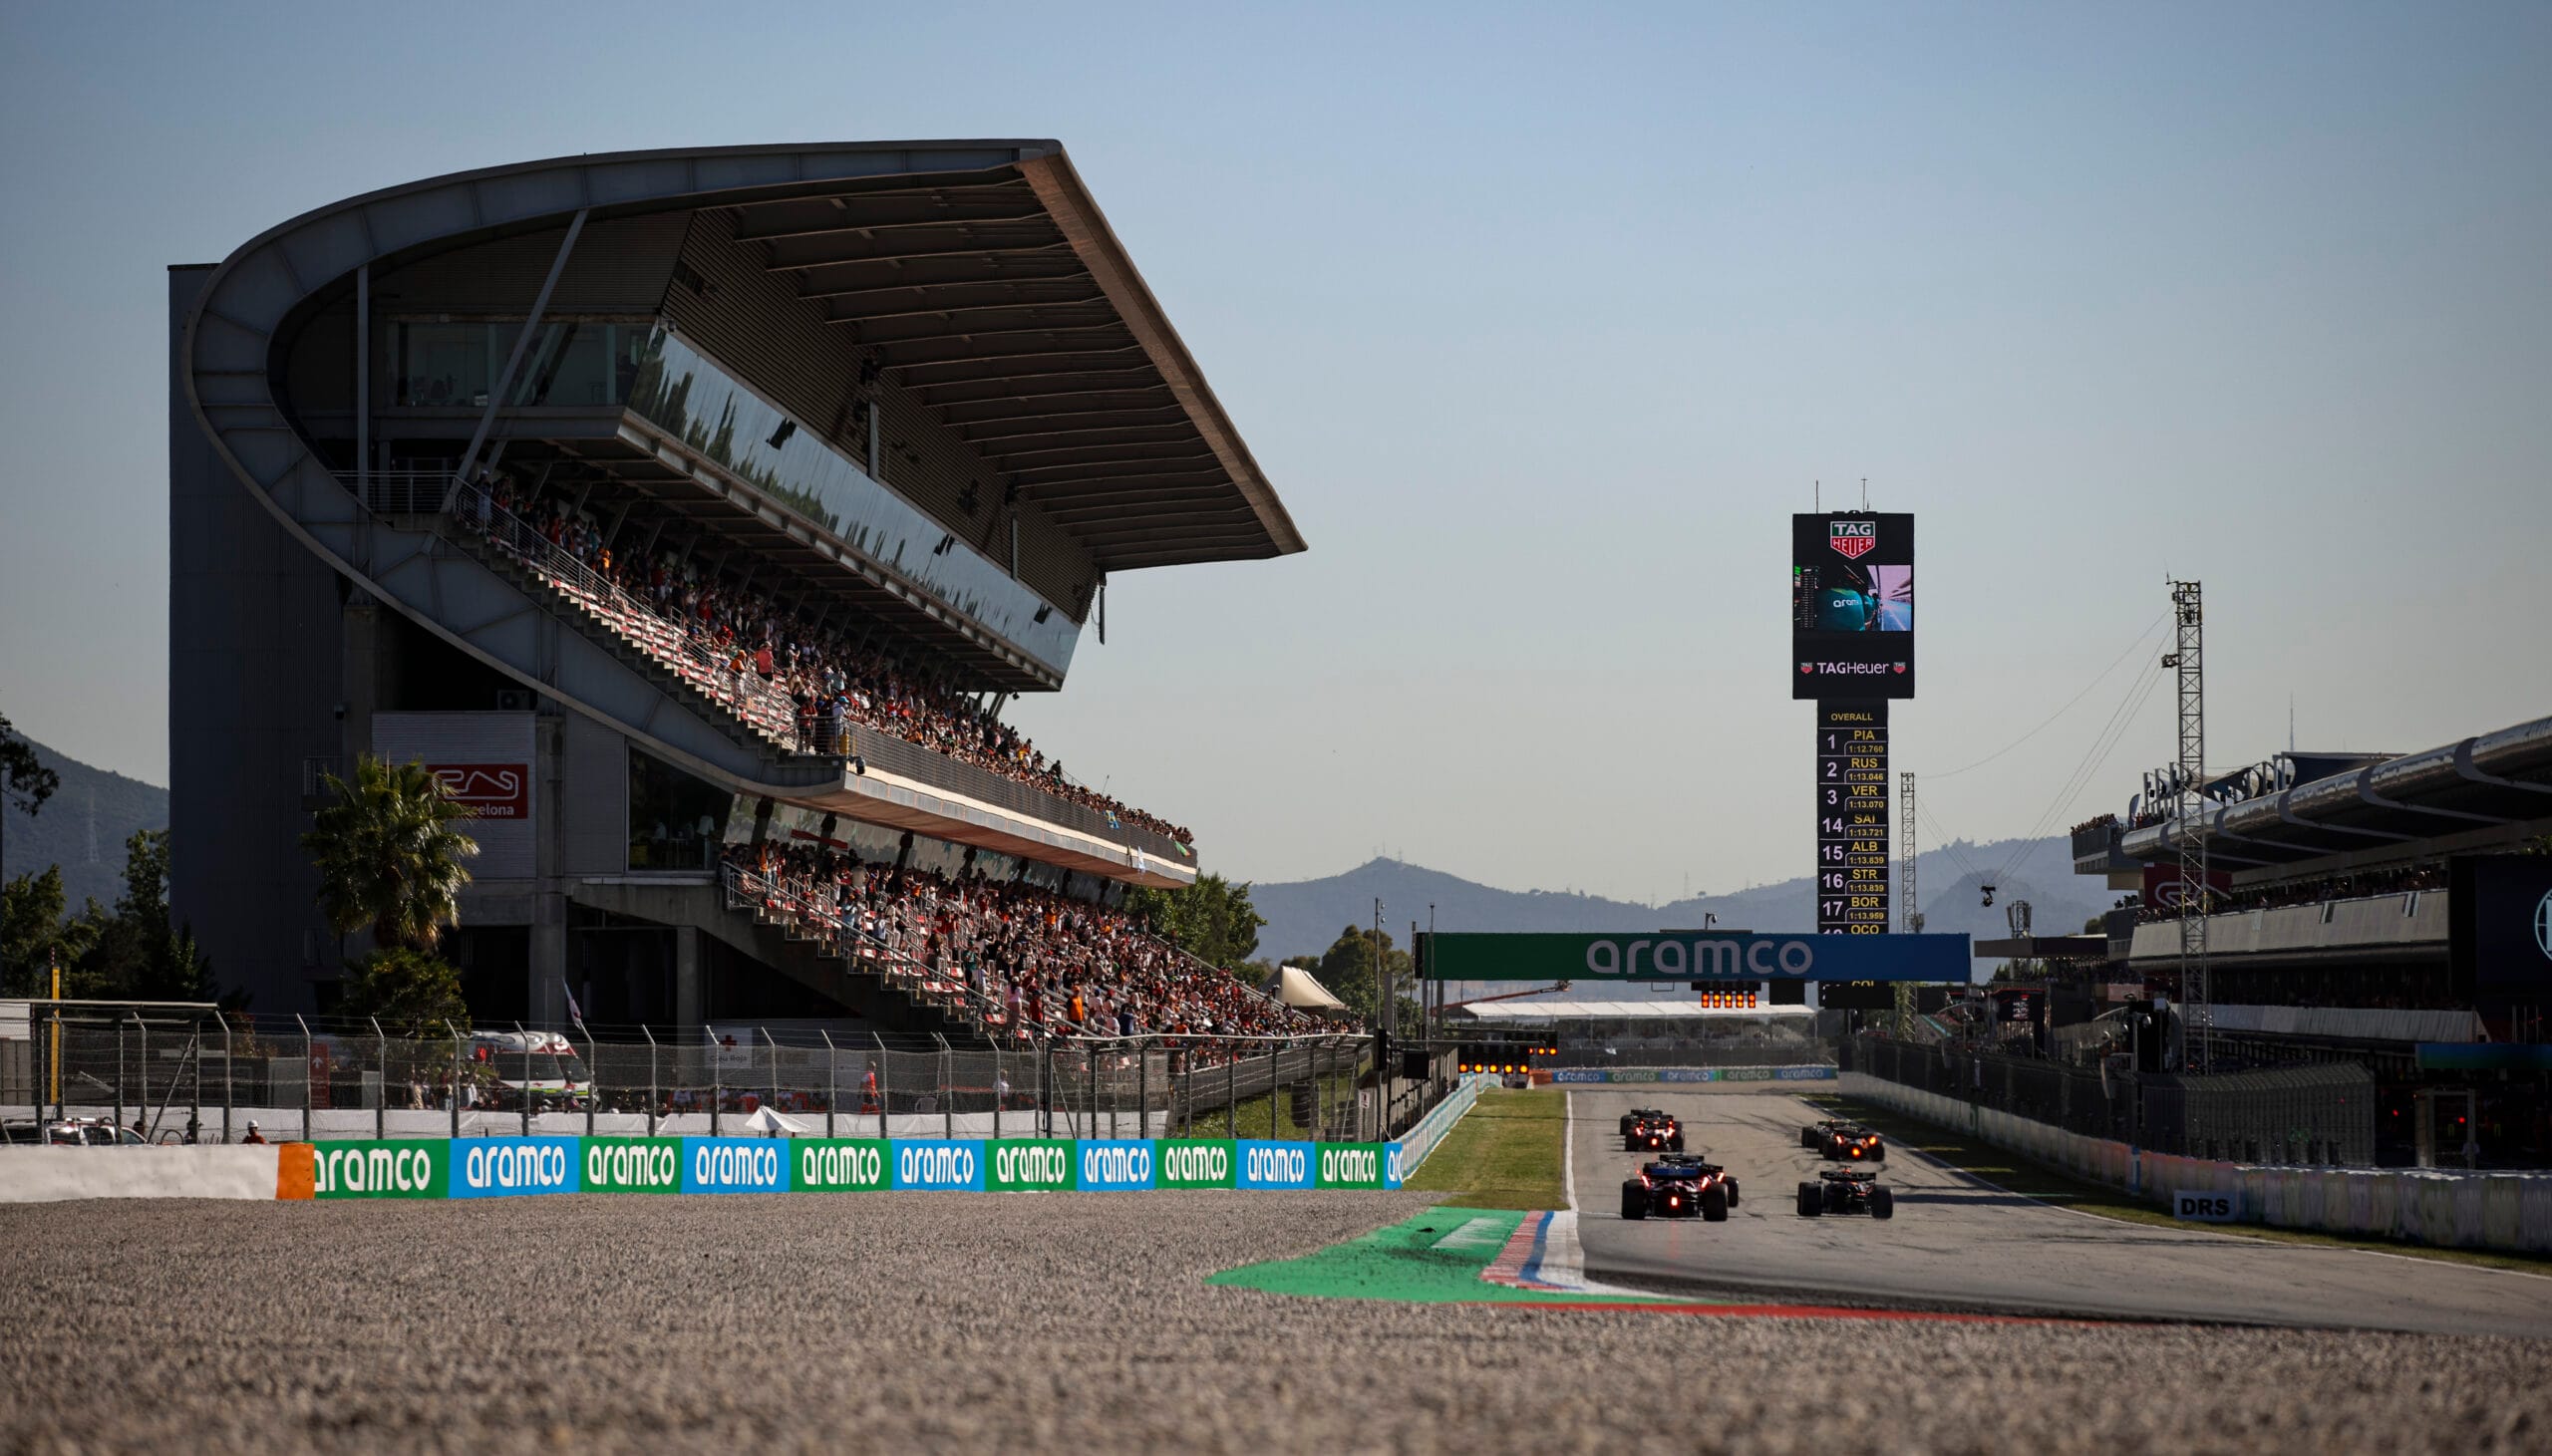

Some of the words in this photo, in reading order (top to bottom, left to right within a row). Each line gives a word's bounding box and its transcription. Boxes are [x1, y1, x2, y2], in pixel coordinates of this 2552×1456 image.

[1834, 524, 1871, 536] TAG
[1833, 538, 1873, 556] HEUER
[1827, 733, 1835, 749] 1
[1854, 729, 1875, 739] PIA
[1826, 761, 1837, 777] 2
[1851, 757, 1878, 767] RUS
[1826, 789, 1838, 805] 3
[1851, 785, 1878, 795] VER
[1822, 817, 1843, 833] 14
[1822, 845, 1843, 860] 15
[1852, 841, 1878, 851] ALB
[1822, 873, 1844, 889] 16
[1852, 869, 1878, 880] STR
[1822, 901, 1843, 917] 17
[1851, 897, 1880, 907] BOR
[1850, 924, 1880, 935] OCO
[1586, 940, 1813, 975] aramco
[1558, 1072, 1599, 1081] aramco
[1613, 1072, 1656, 1081] aramco
[1729, 1070, 1770, 1080] aramco
[1781, 1069, 1823, 1078] aramco
[314, 1148, 431, 1191] aramco
[467, 1146, 565, 1188] aramco
[588, 1146, 676, 1186] aramco
[696, 1146, 777, 1185] aramco
[802, 1146, 881, 1185] aramco
[901, 1146, 974, 1184] aramco
[997, 1146, 1065, 1183] aramco
[1085, 1146, 1150, 1182] aramco
[1165, 1146, 1227, 1181] aramco
[1248, 1148, 1305, 1182] aramco
[1322, 1149, 1376, 1182] aramco
[2181, 1198, 2229, 1216] DRS
